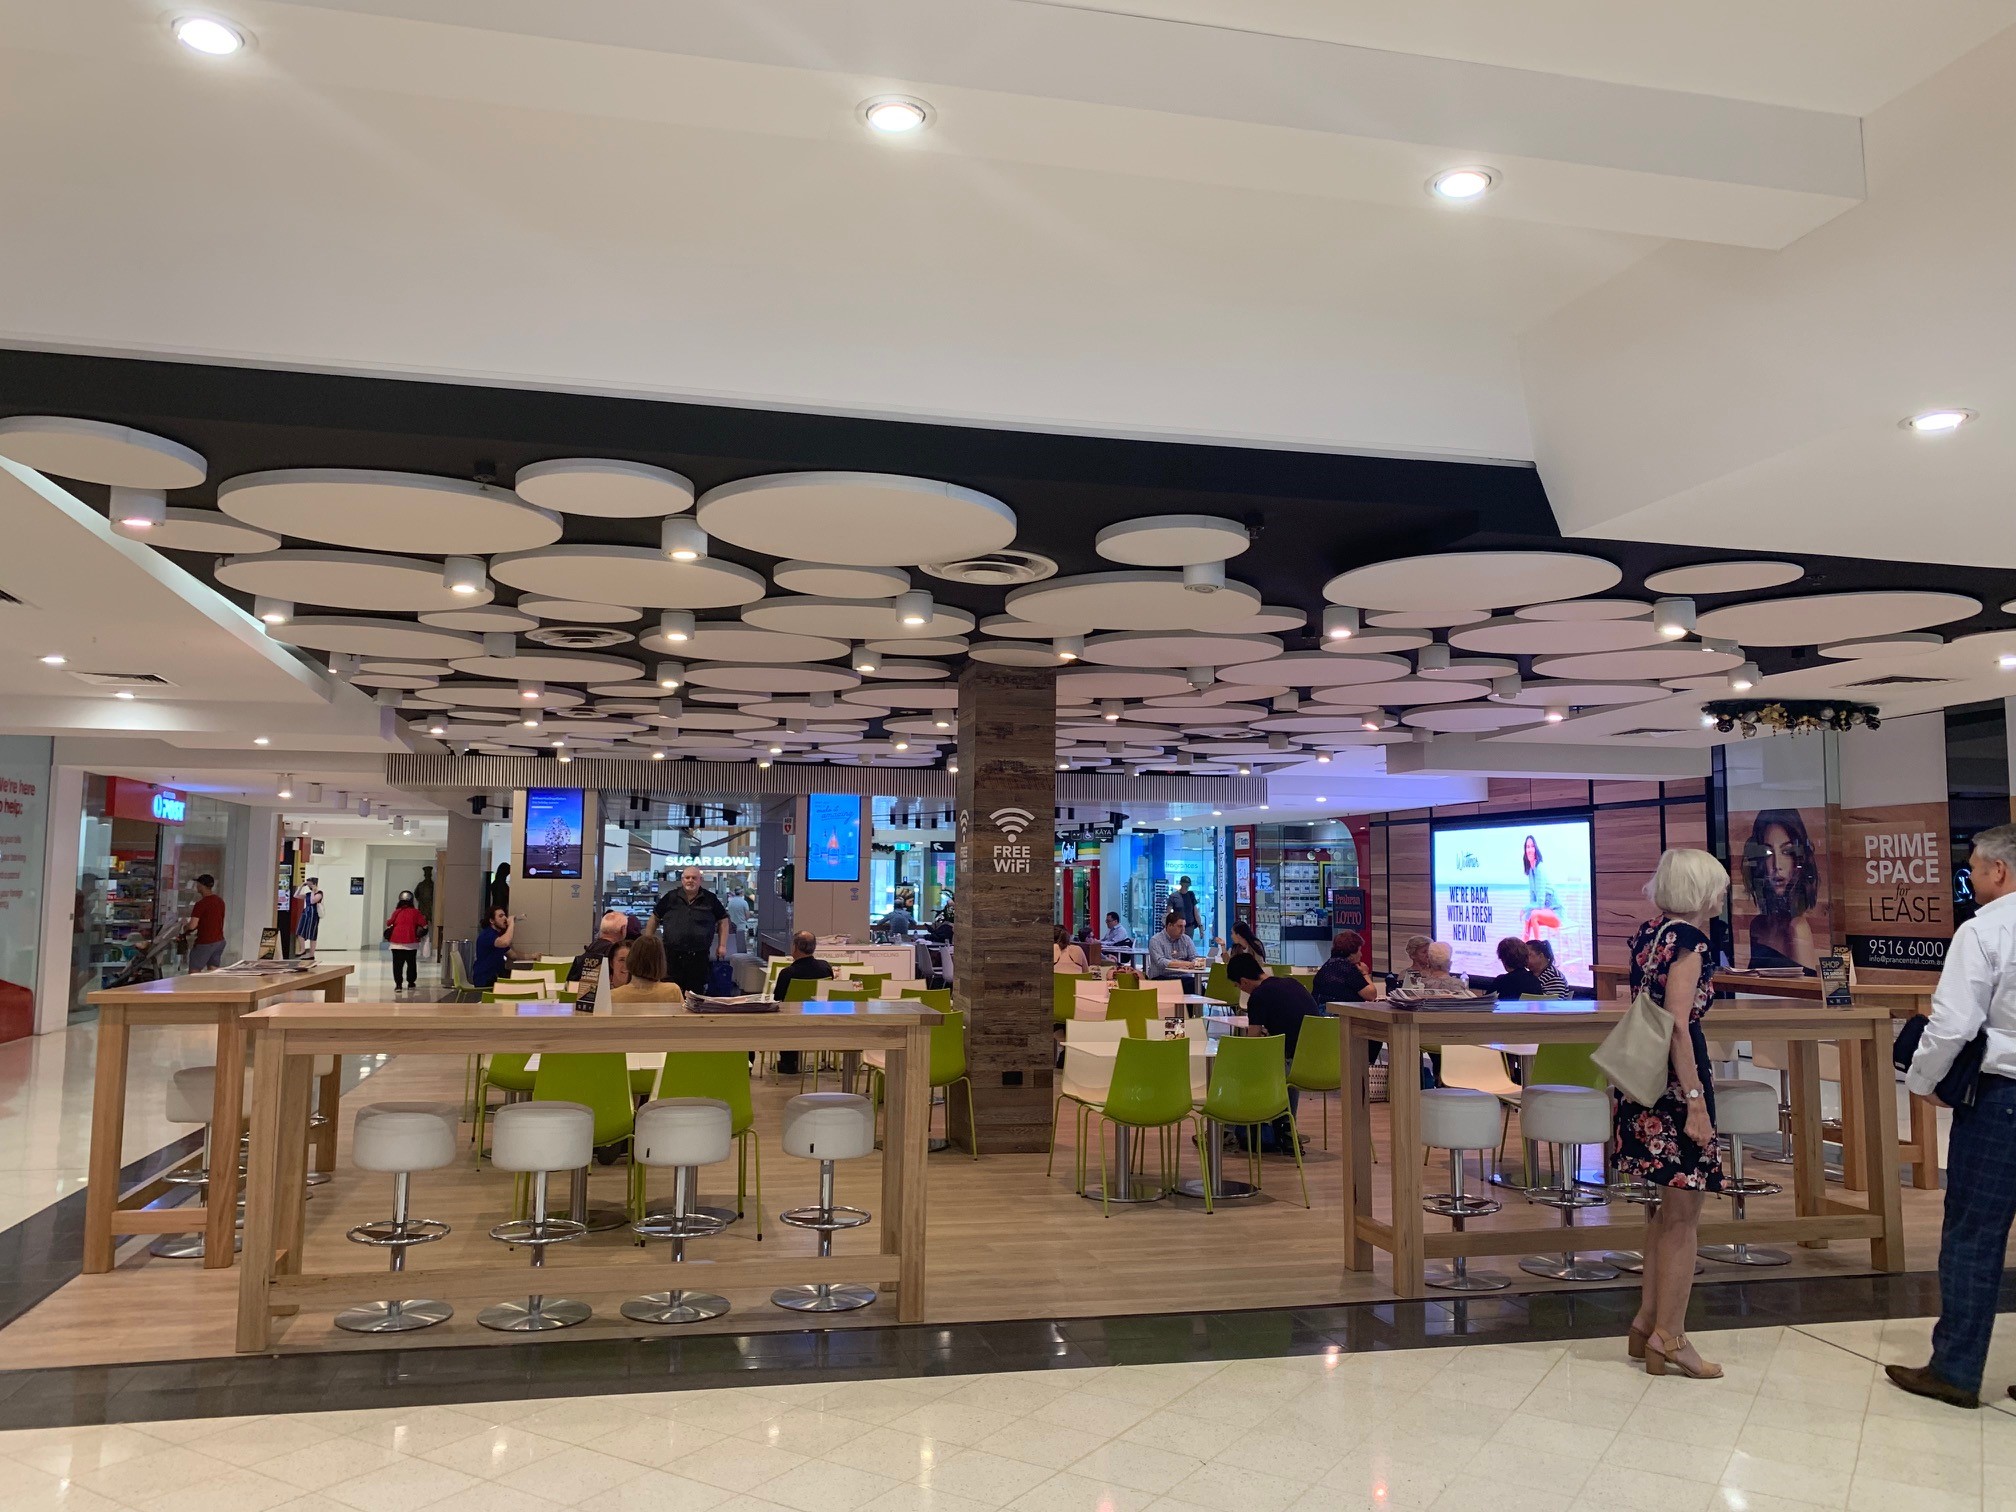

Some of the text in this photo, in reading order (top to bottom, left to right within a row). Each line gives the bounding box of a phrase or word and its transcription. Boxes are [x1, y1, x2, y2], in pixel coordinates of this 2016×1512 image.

[20, 780, 36, 796] here
[993, 845, 1031, 858] FREE
[1864, 832, 1939, 858] PRIME
[665, 856, 711, 867] SUGAR
[713, 856, 753, 867] BOWL
[993, 858, 1030, 873] WiFi
[1865, 858, 1940, 884] SPACE
[1335, 894, 1360, 905] Prahran
[1449, 886, 1489, 903] WE'RE BACK
[1894, 882, 1911, 901] for
[1447, 905, 1493, 923] WITH A FRESH
[1869, 896, 1942, 922] LEASE
[1336, 910, 1362, 925] LOTTO
[1453, 924, 1487, 942] NEW LOOK
[1869, 939, 1944, 957] 9516 6000
[583, 957, 599, 968] SHOP
[1821, 960, 1840, 969] SHOP
